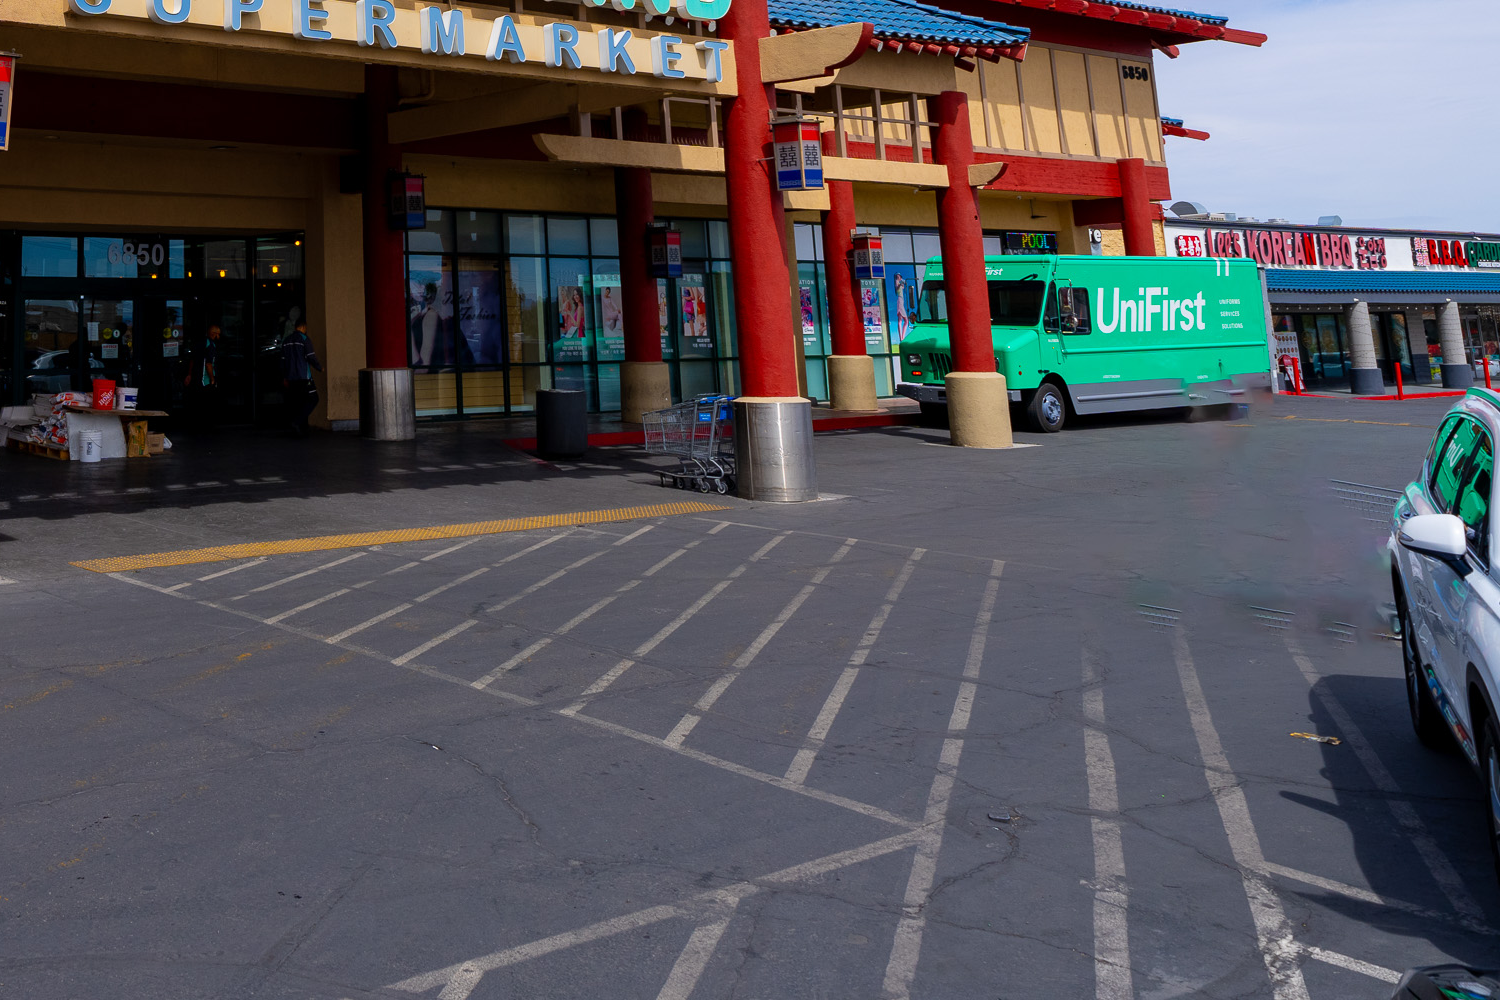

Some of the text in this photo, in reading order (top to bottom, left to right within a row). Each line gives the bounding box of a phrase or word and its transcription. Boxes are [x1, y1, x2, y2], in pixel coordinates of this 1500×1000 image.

[108, 242, 164, 266] 6850
[1022, 233, 1050, 249] POOL
[1245, 230, 1317, 265] KOREAN
[1318, 233, 1354, 268] BBQ
[1097, 287, 1206, 333] UniFirst
